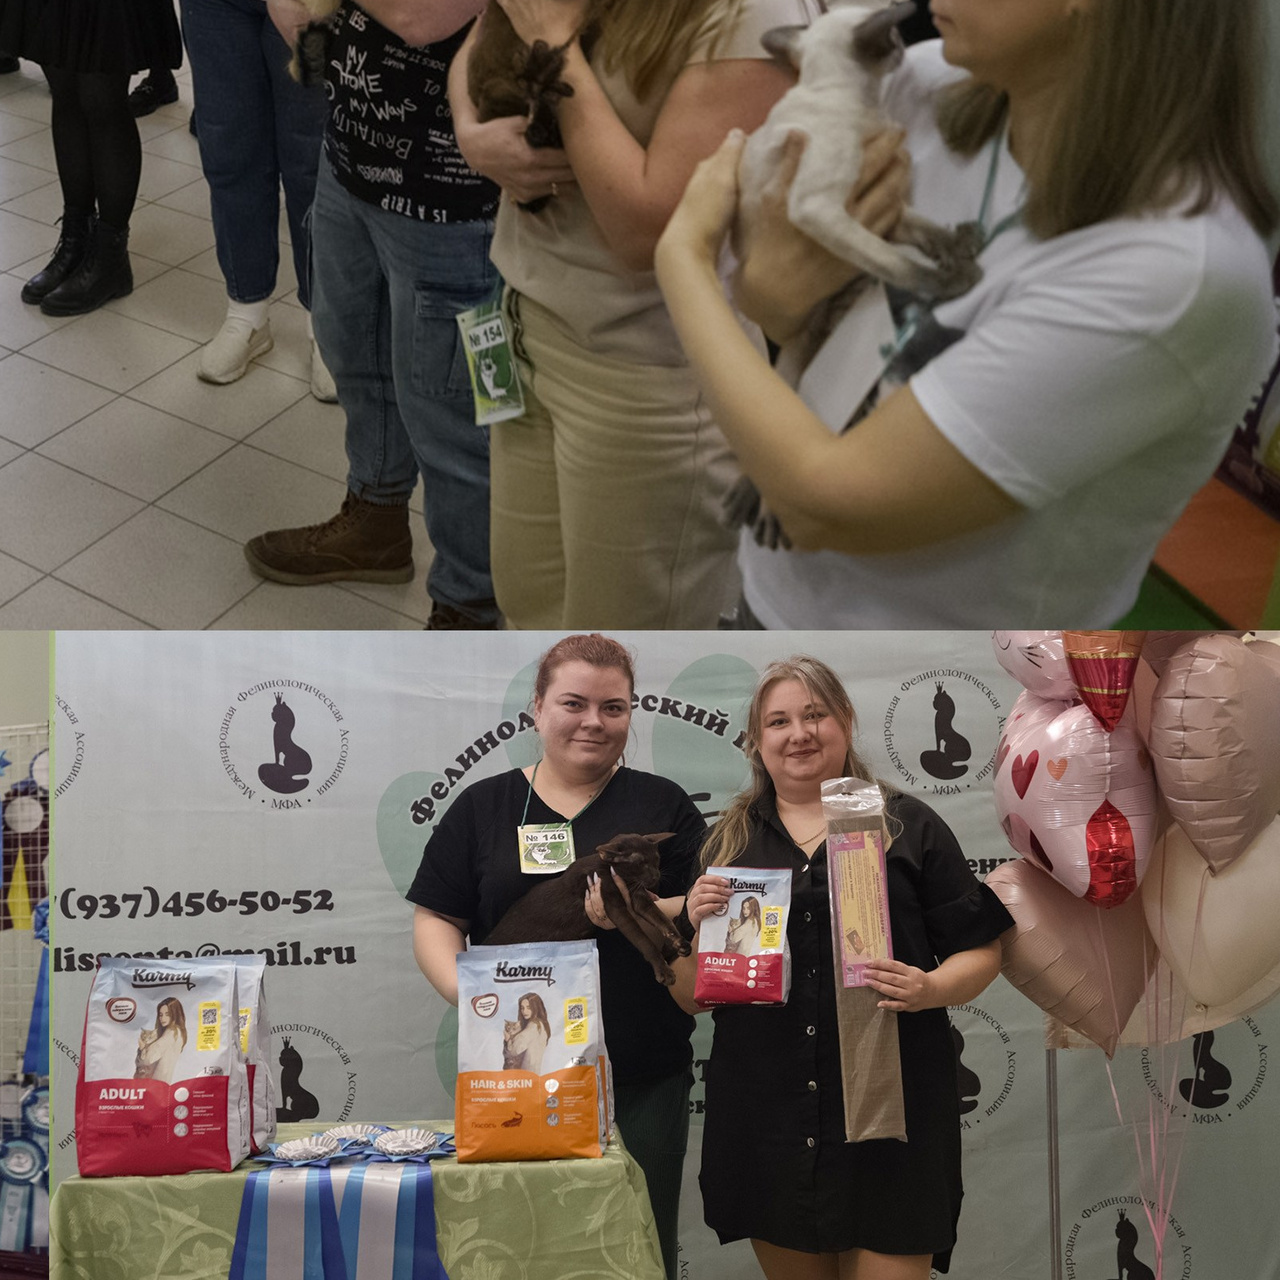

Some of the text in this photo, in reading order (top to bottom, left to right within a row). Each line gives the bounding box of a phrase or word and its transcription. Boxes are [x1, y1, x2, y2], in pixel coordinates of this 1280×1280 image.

[345, 44, 368, 74] My
[349, 97, 418, 122] My Ways
[332, 104, 413, 160] BRUTALITY
[381, 194, 447, 223] IS A TRIP
[483, 324, 503, 344] 154
[900, 668, 1001, 710] Фелинологическая
[218, 678, 350, 801] Международная Фелинологическая Ассоциация
[884, 695, 918, 786] Международная
[932, 783, 962, 795] МФА
[270, 797, 302, 810] МФА
[543, 832, 566, 841] 146
[729, 877, 768, 896] Karmy
[57, 886, 335, 920] (937)456-50-52
[494, 960, 556, 986] Karmy
[704, 956, 737, 968] ADULT
[132, 969, 195, 990] Karmy
[270, 1023, 358, 1123] инологическая Ассоциа
[946, 1004, 1017, 1117] ологическая Ассоциация
[470, 1078, 533, 1089] HAIR & SKIN
[1235, 1042, 1268, 1111] Ассоциация
[99, 1088, 147, 1100] ADULT
[1192, 1113, 1223, 1124] МФА
[1064, 1223, 1082, 1280] народная
[1081, 1195, 1186, 1239] Фелинолоикая
